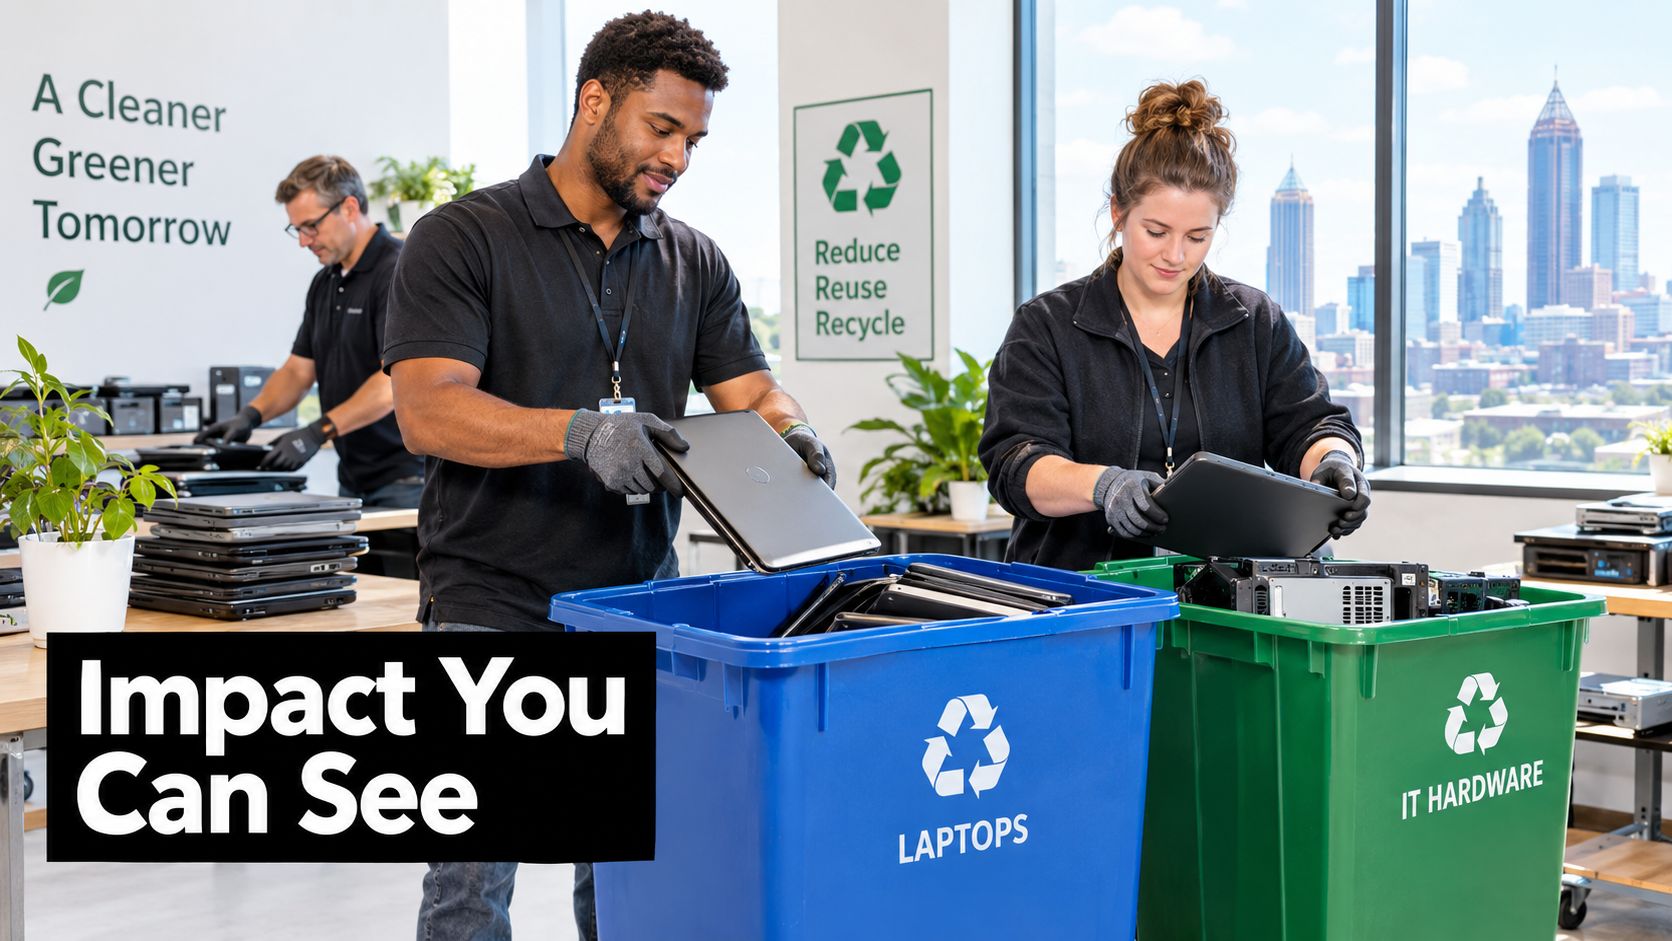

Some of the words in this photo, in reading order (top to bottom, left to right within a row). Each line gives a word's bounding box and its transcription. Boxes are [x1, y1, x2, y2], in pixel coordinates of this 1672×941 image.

[31, 73, 63, 115] A
[77, 79, 227, 133] Cleaner
[32, 136, 195, 187] Greener
[32, 199, 232, 246] Tomorrow
[815, 237, 901, 266] Reduce
[815, 275, 888, 301] Reuse
[815, 308, 905, 342] Recycle
[1402, 788, 1421, 820] IT
[1428, 759, 1544, 813] HARDWARE
[899, 813, 1029, 864] LAPTOPS
